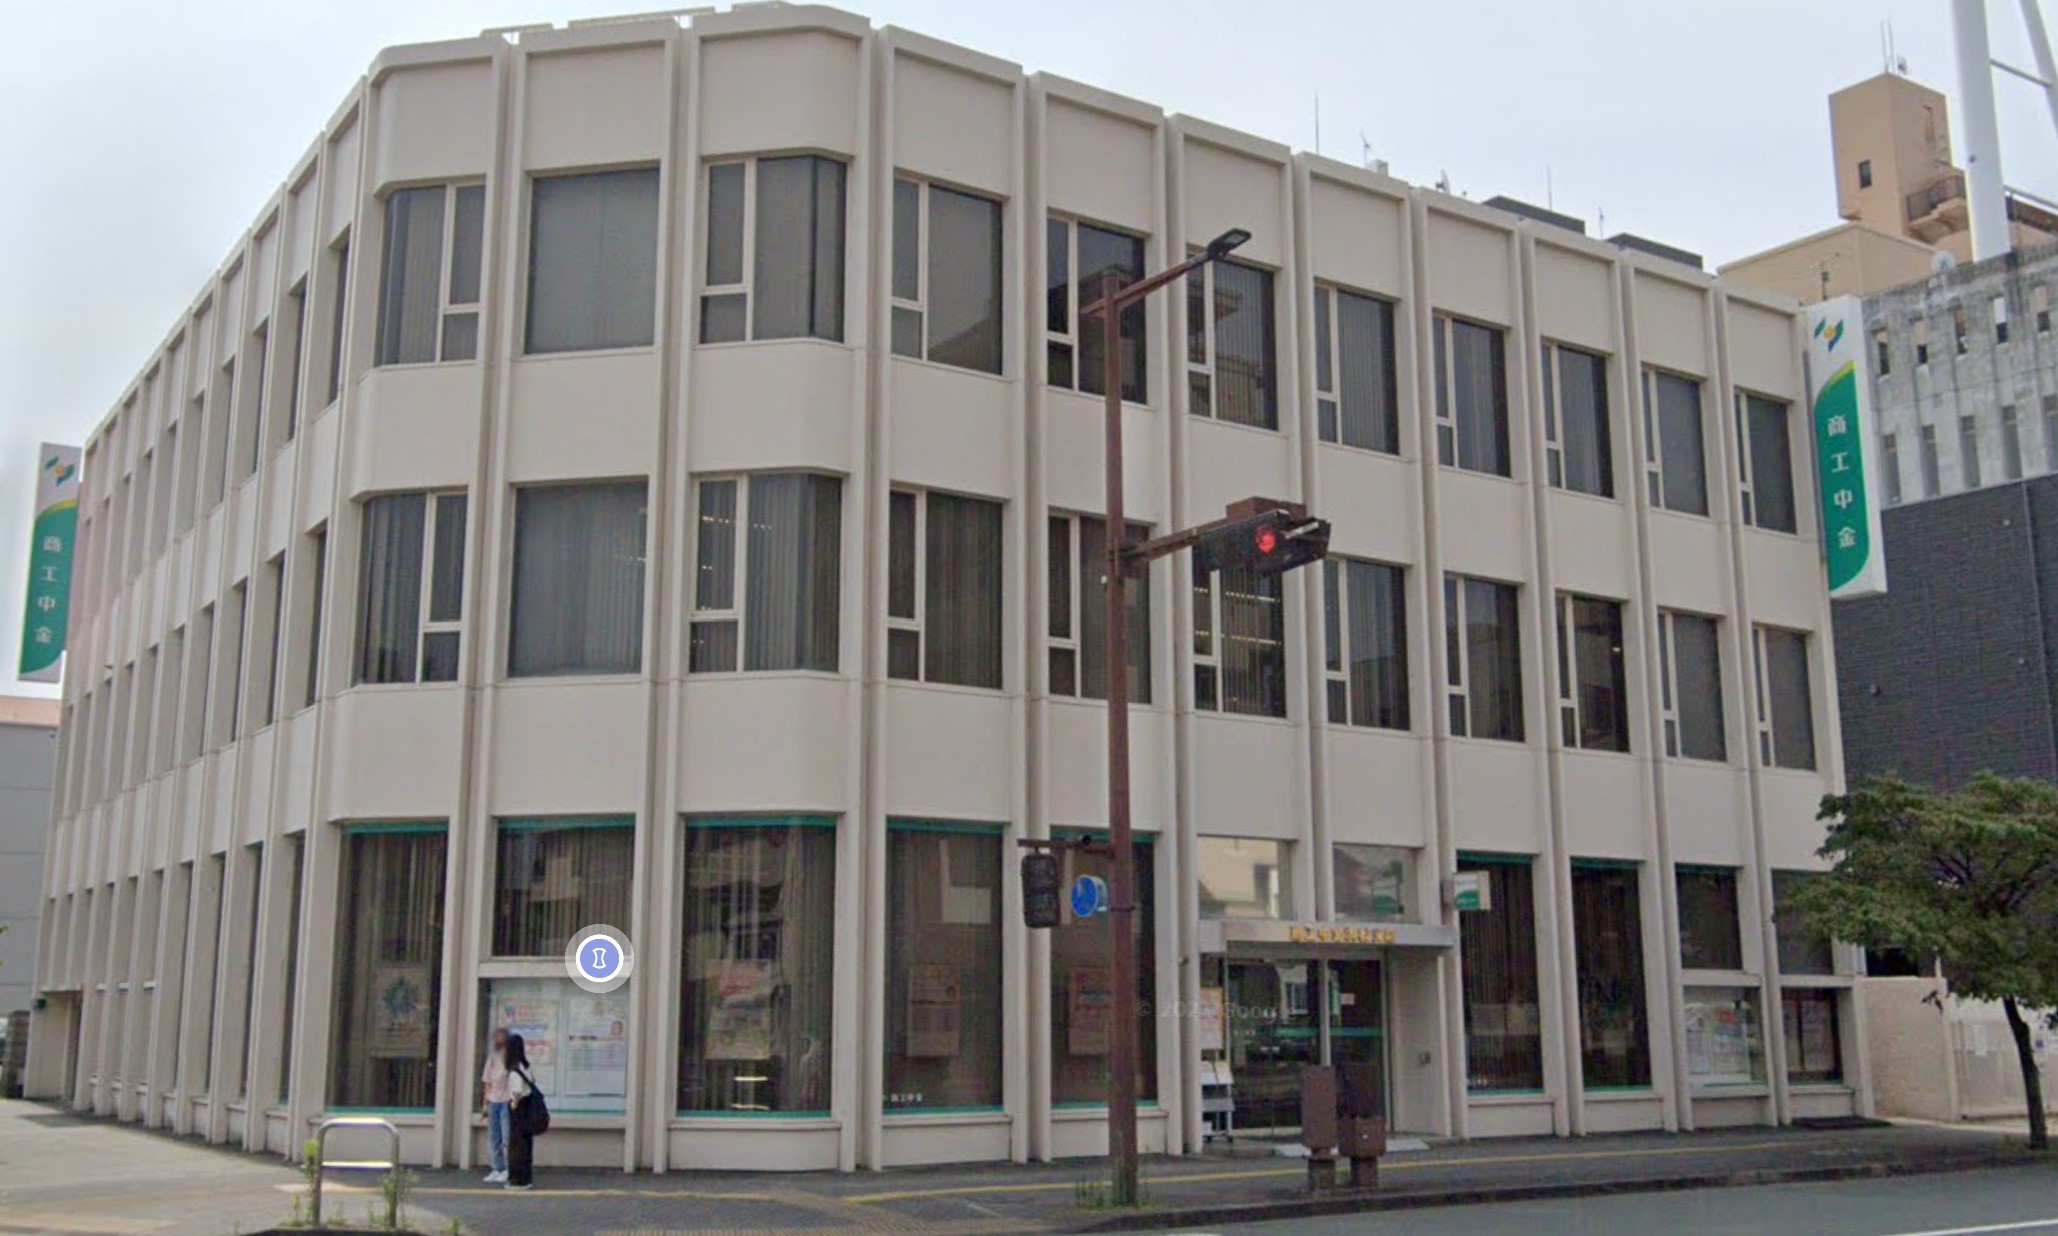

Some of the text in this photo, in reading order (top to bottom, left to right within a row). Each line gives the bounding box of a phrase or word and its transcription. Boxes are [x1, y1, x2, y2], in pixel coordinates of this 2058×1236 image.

[1828, 416, 1856, 548] 商工中金
[35, 536, 61, 644] 商工中金
